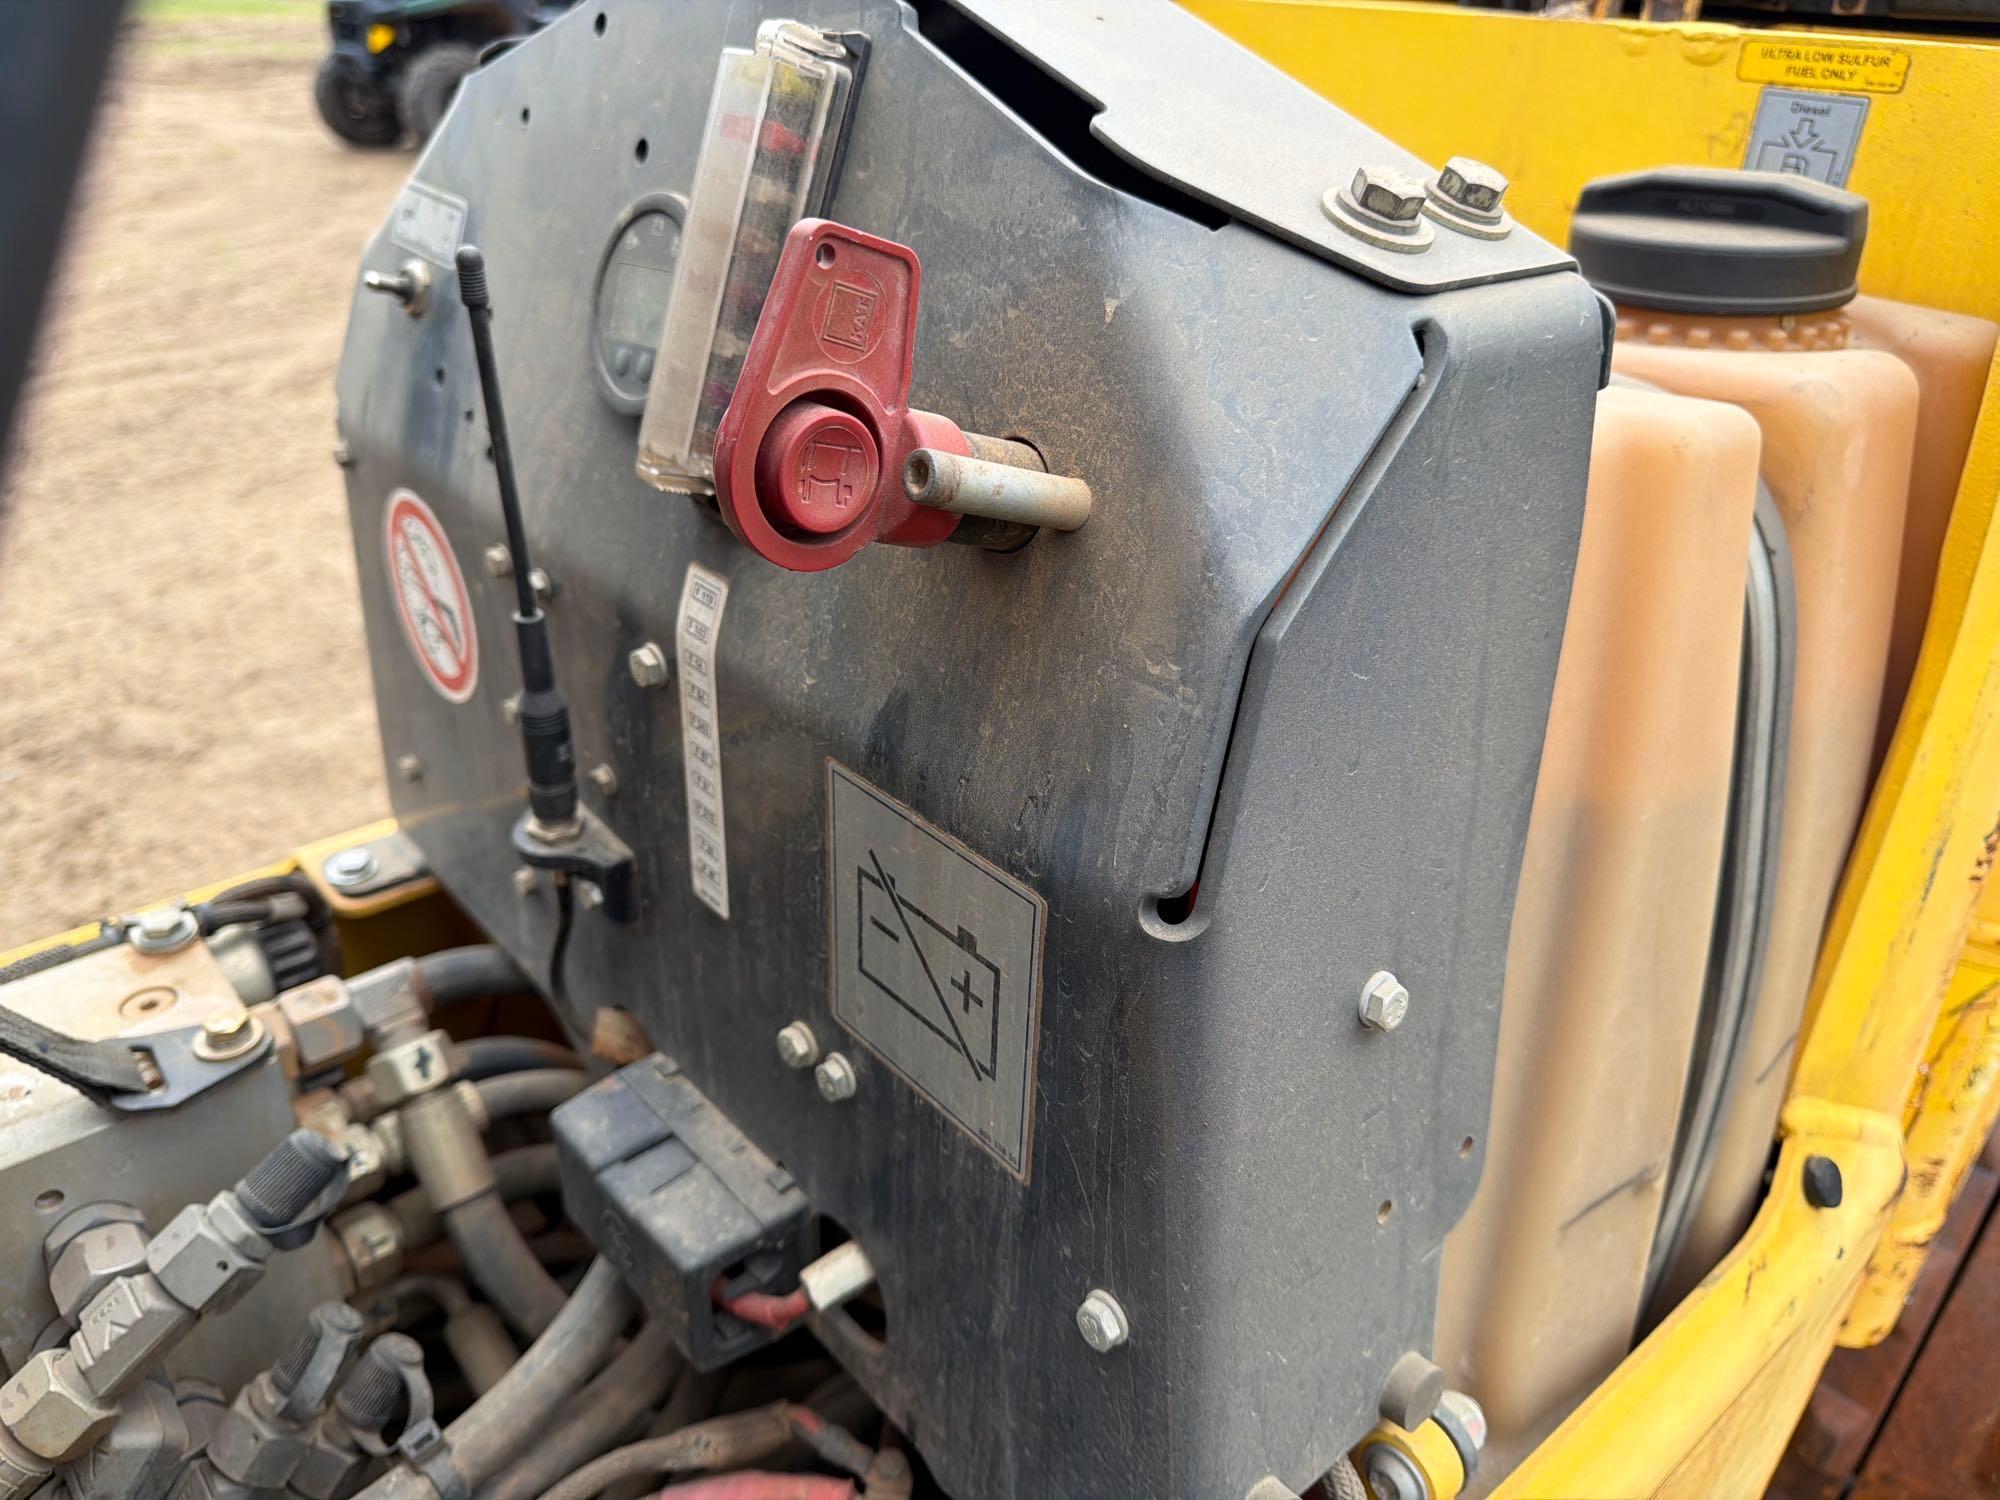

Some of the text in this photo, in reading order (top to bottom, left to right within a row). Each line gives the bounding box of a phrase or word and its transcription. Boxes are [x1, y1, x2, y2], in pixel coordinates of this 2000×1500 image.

[1760, 47, 1891, 68] ULTRA LOW SULFUR
[1785, 65, 1856, 81] FUEL ONLY
[1790, 101, 1832, 116] Diesel
